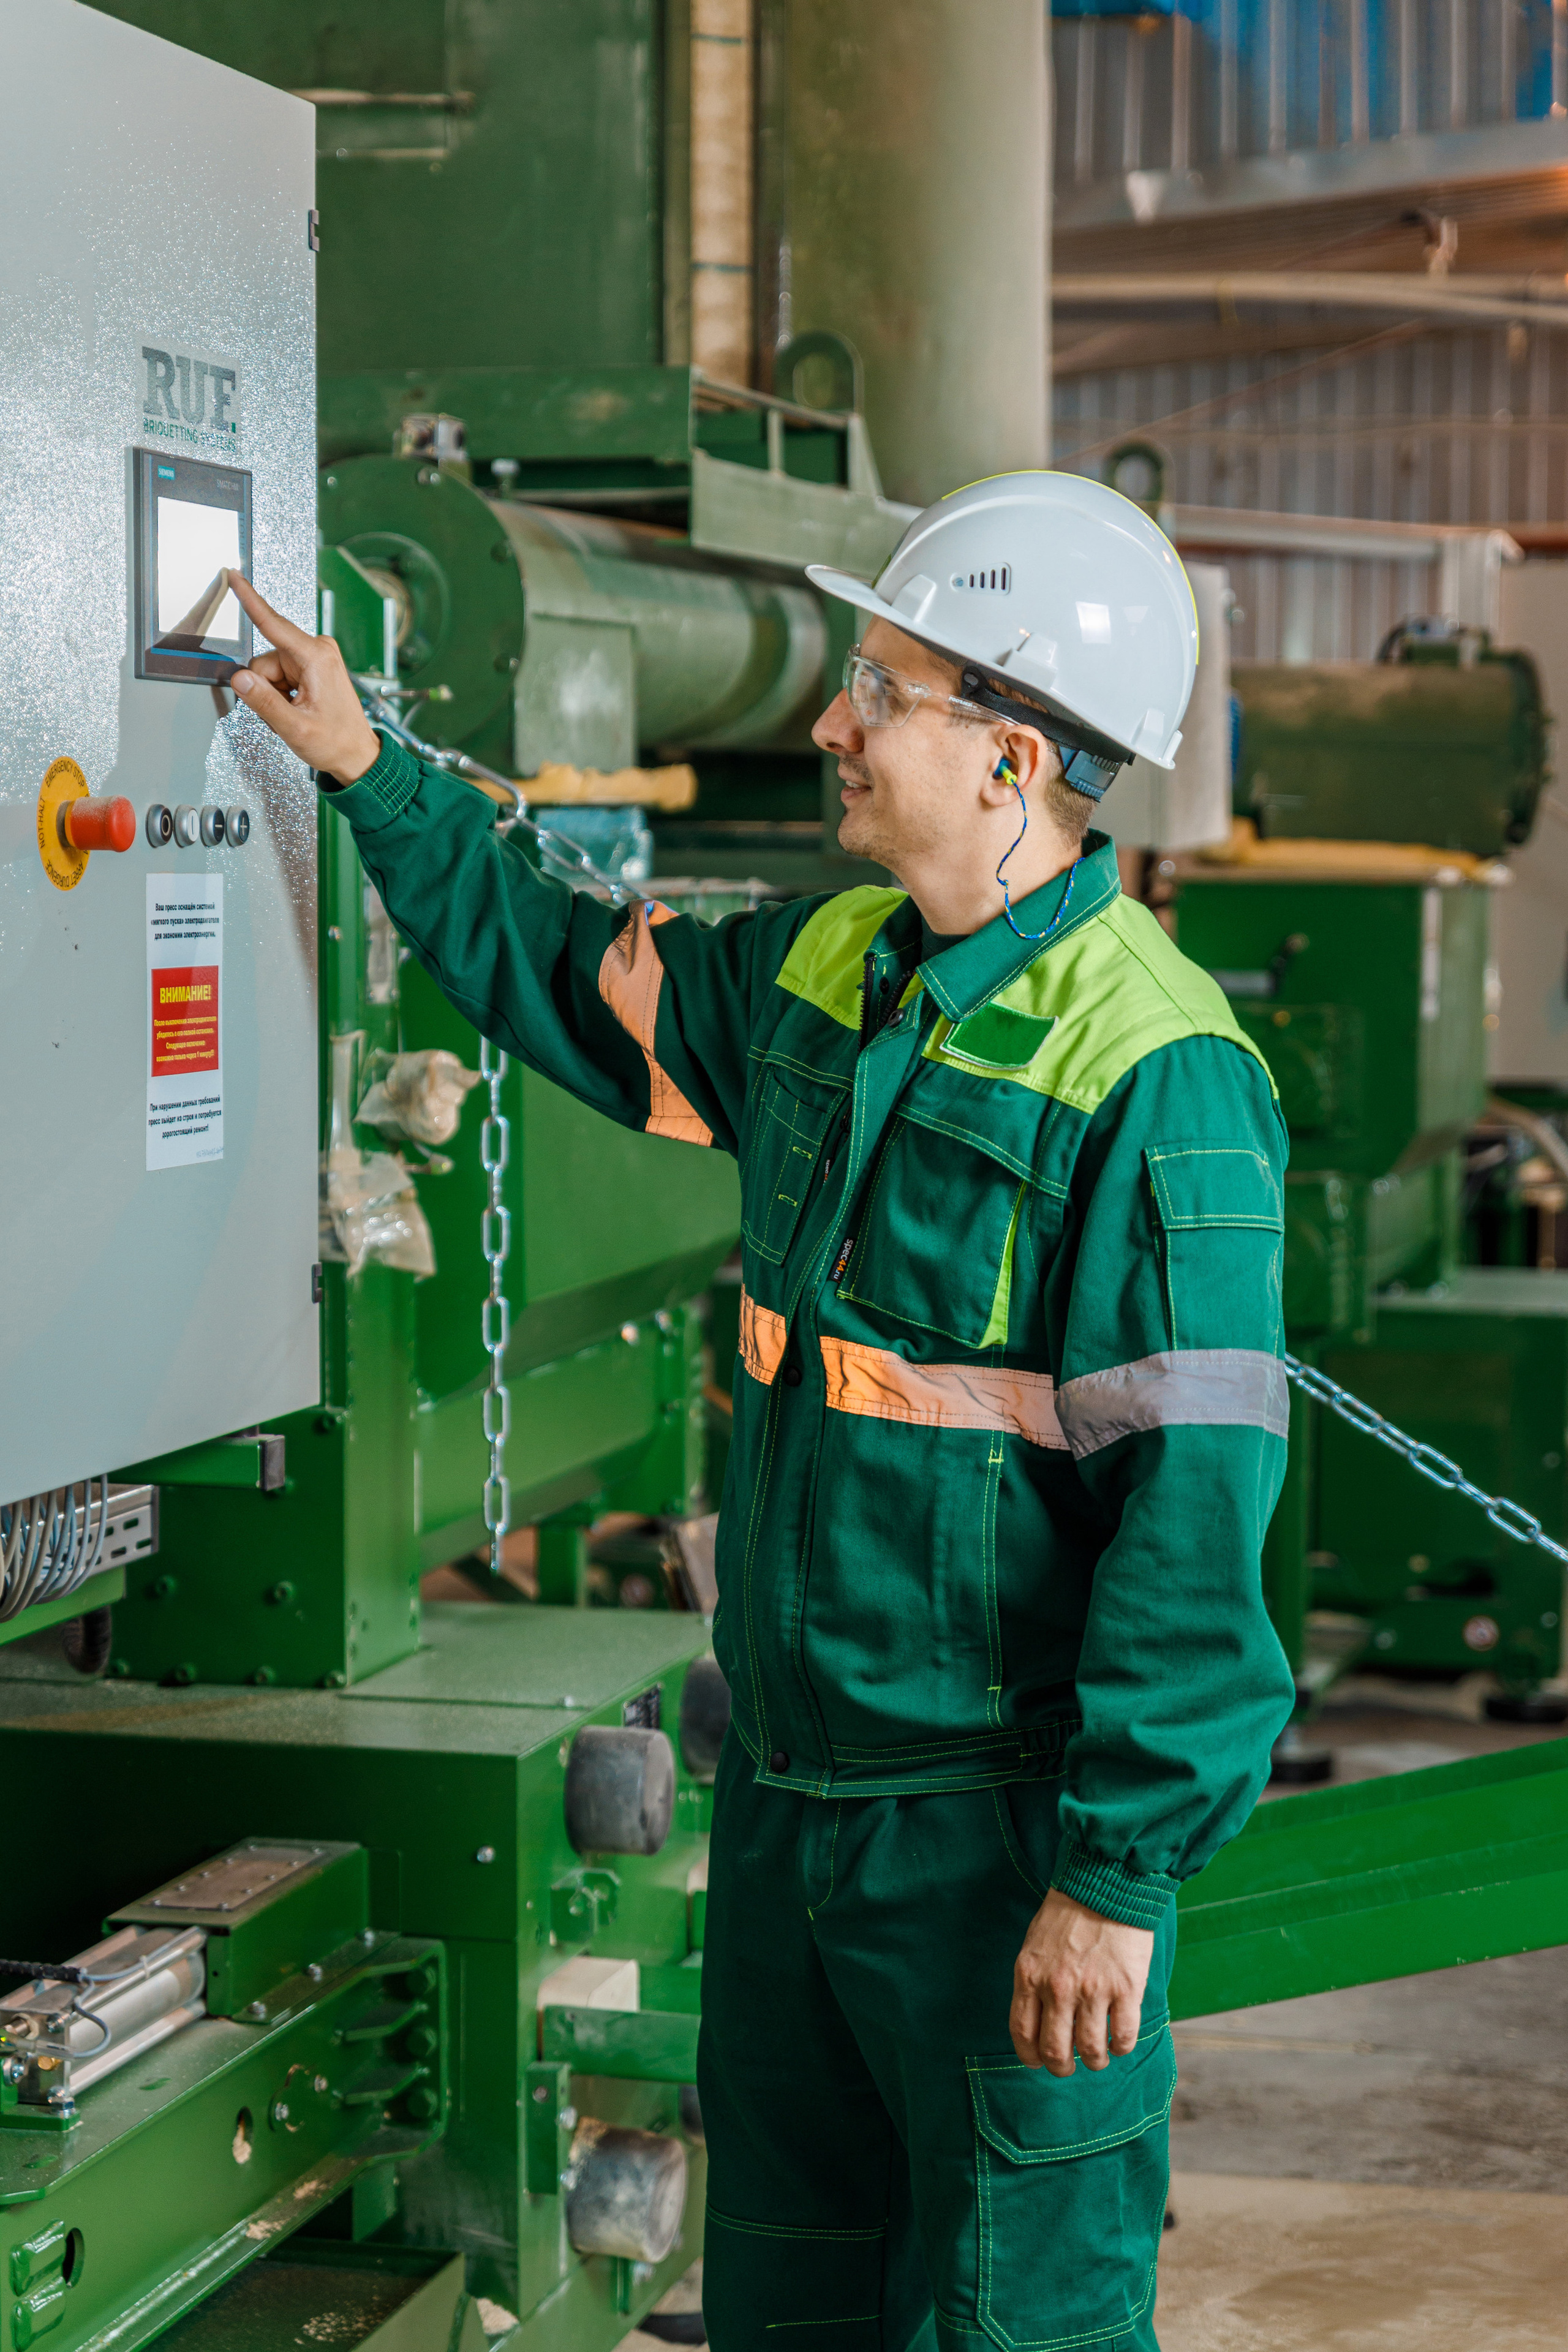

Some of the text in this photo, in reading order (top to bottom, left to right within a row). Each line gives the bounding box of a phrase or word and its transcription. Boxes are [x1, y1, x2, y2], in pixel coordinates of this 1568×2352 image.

[143, 418, 198, 443] BRIQUETTING
[158, 467, 174, 478] SIEMENS
[45, 760, 85, 788] EMERGENCY STOP
[155, 903, 164, 911] Ваш
[165, 904, 177, 913] пресс
[178, 902, 196, 913] оснащён
[160, 984, 211, 1004] ВНИМАНИЕ!
[149, 1095, 220, 1113] При нарушении данных требований
[148, 1118, 160, 1127] пресс
[161, 1115, 176, 1125] выйдет
[183, 1114, 194, 1123] строя
[198, 1109, 221, 1120] потребуется
[162, 1124, 209, 1139] дорогостоящий ремонт!
[834, 1238, 853, 1280] spec44.ru
